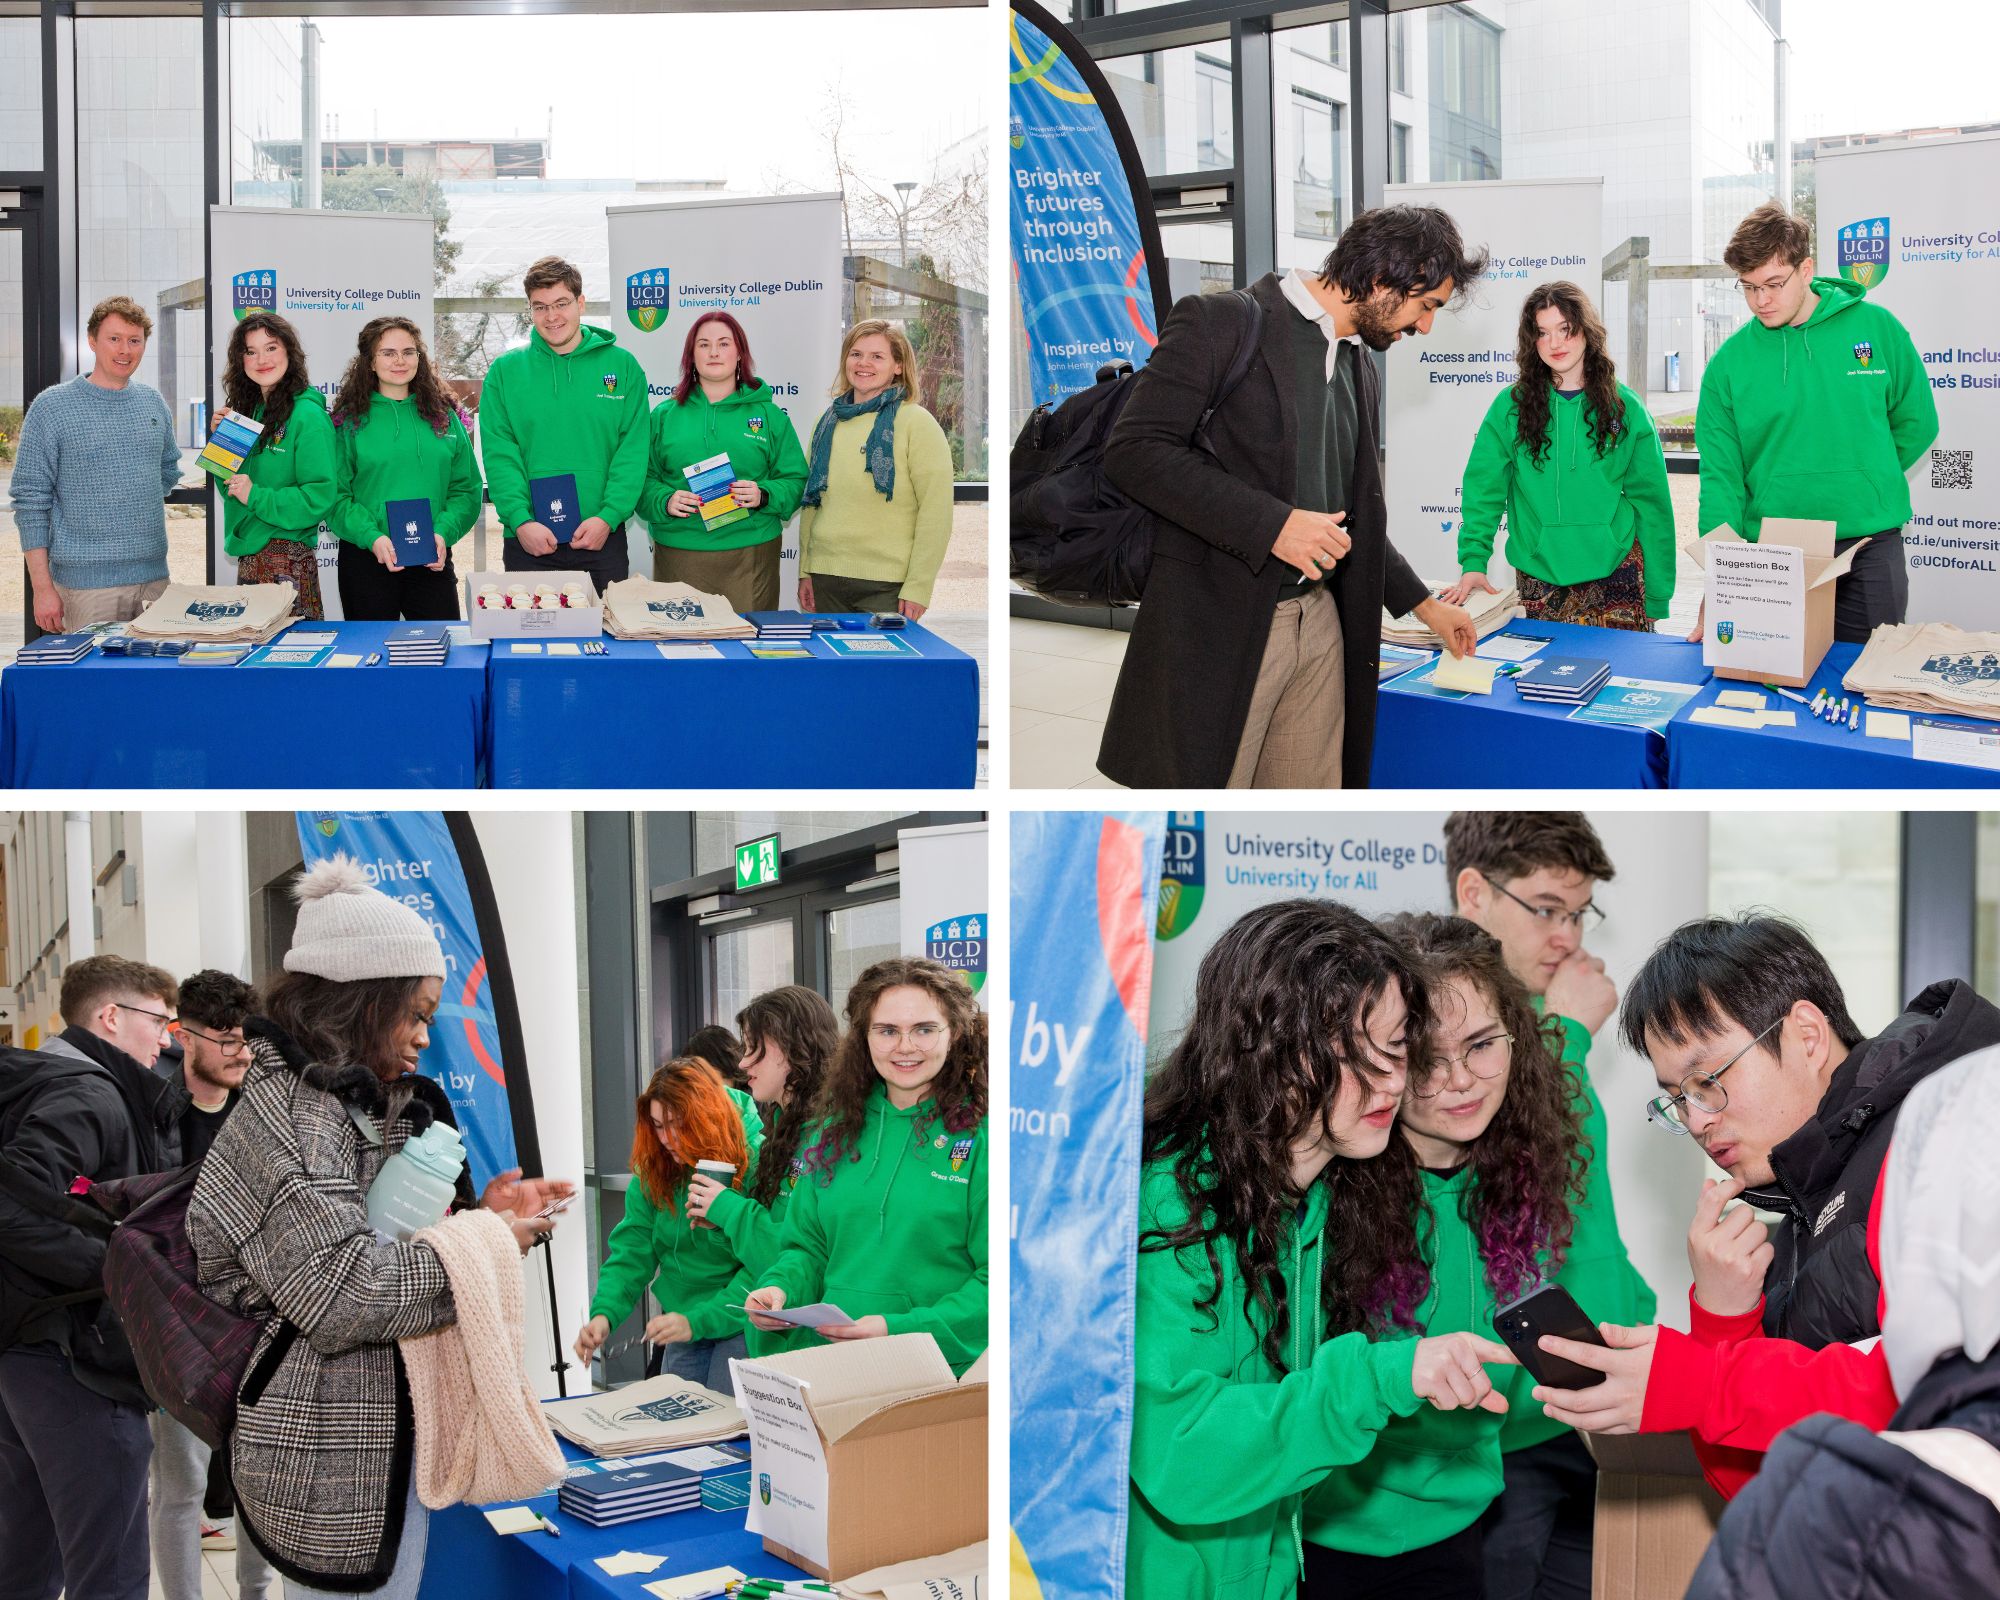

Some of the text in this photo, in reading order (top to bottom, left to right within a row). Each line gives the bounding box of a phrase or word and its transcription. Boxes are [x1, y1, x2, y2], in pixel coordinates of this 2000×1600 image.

[1015, 166, 1102, 190] Brighter
[1025, 194, 1104, 213] futures
[1025, 216, 1113, 240] through
[1844, 240, 1884, 254] UCD
[1902, 234, 1973, 248] University
[1023, 242, 1121, 263] inclusion
[1902, 250, 1962, 262] University
[1967, 248, 1984, 259] for
[1508, 257, 1548, 268] College
[1551, 255, 1586, 266] Dublin
[1500, 270, 1514, 278] for
[1516, 270, 1528, 278] All
[238, 287, 272, 299] UCD
[286, 288, 421, 301] University College Dublin
[631, 287, 665, 299] UCD
[679, 280, 823, 296] University College Dublin
[286, 301, 364, 312] University for All
[679, 297, 760, 309] University for All
[1044, 338, 1135, 359] Inspired by
[1923, 348, 1952, 363] and
[1420, 352, 1464, 362] Access
[1468, 350, 1490, 362] and
[1047, 362, 1066, 371] John
[1068, 361, 1094, 370] Henry
[788, 382, 798, 394] is
[1937, 518, 1958, 527] out
[1962, 520, 2000, 530] more:
[1716, 558, 1790, 571] Suggestion Box
[1911, 555, 1996, 571] @UCDforALL
[1225, 833, 1334, 866] University
[1342, 839, 1416, 870] College
[362, 858, 432, 886] ghter
[1225, 866, 1378, 894] University for All
[932, 941, 980, 959] UCD
[1019, 1001, 1091, 1087] by
[449, 1072, 475, 1093] by
[742, 1384, 803, 1412] Suggestion Box
[794, 1448, 815, 1462] University
